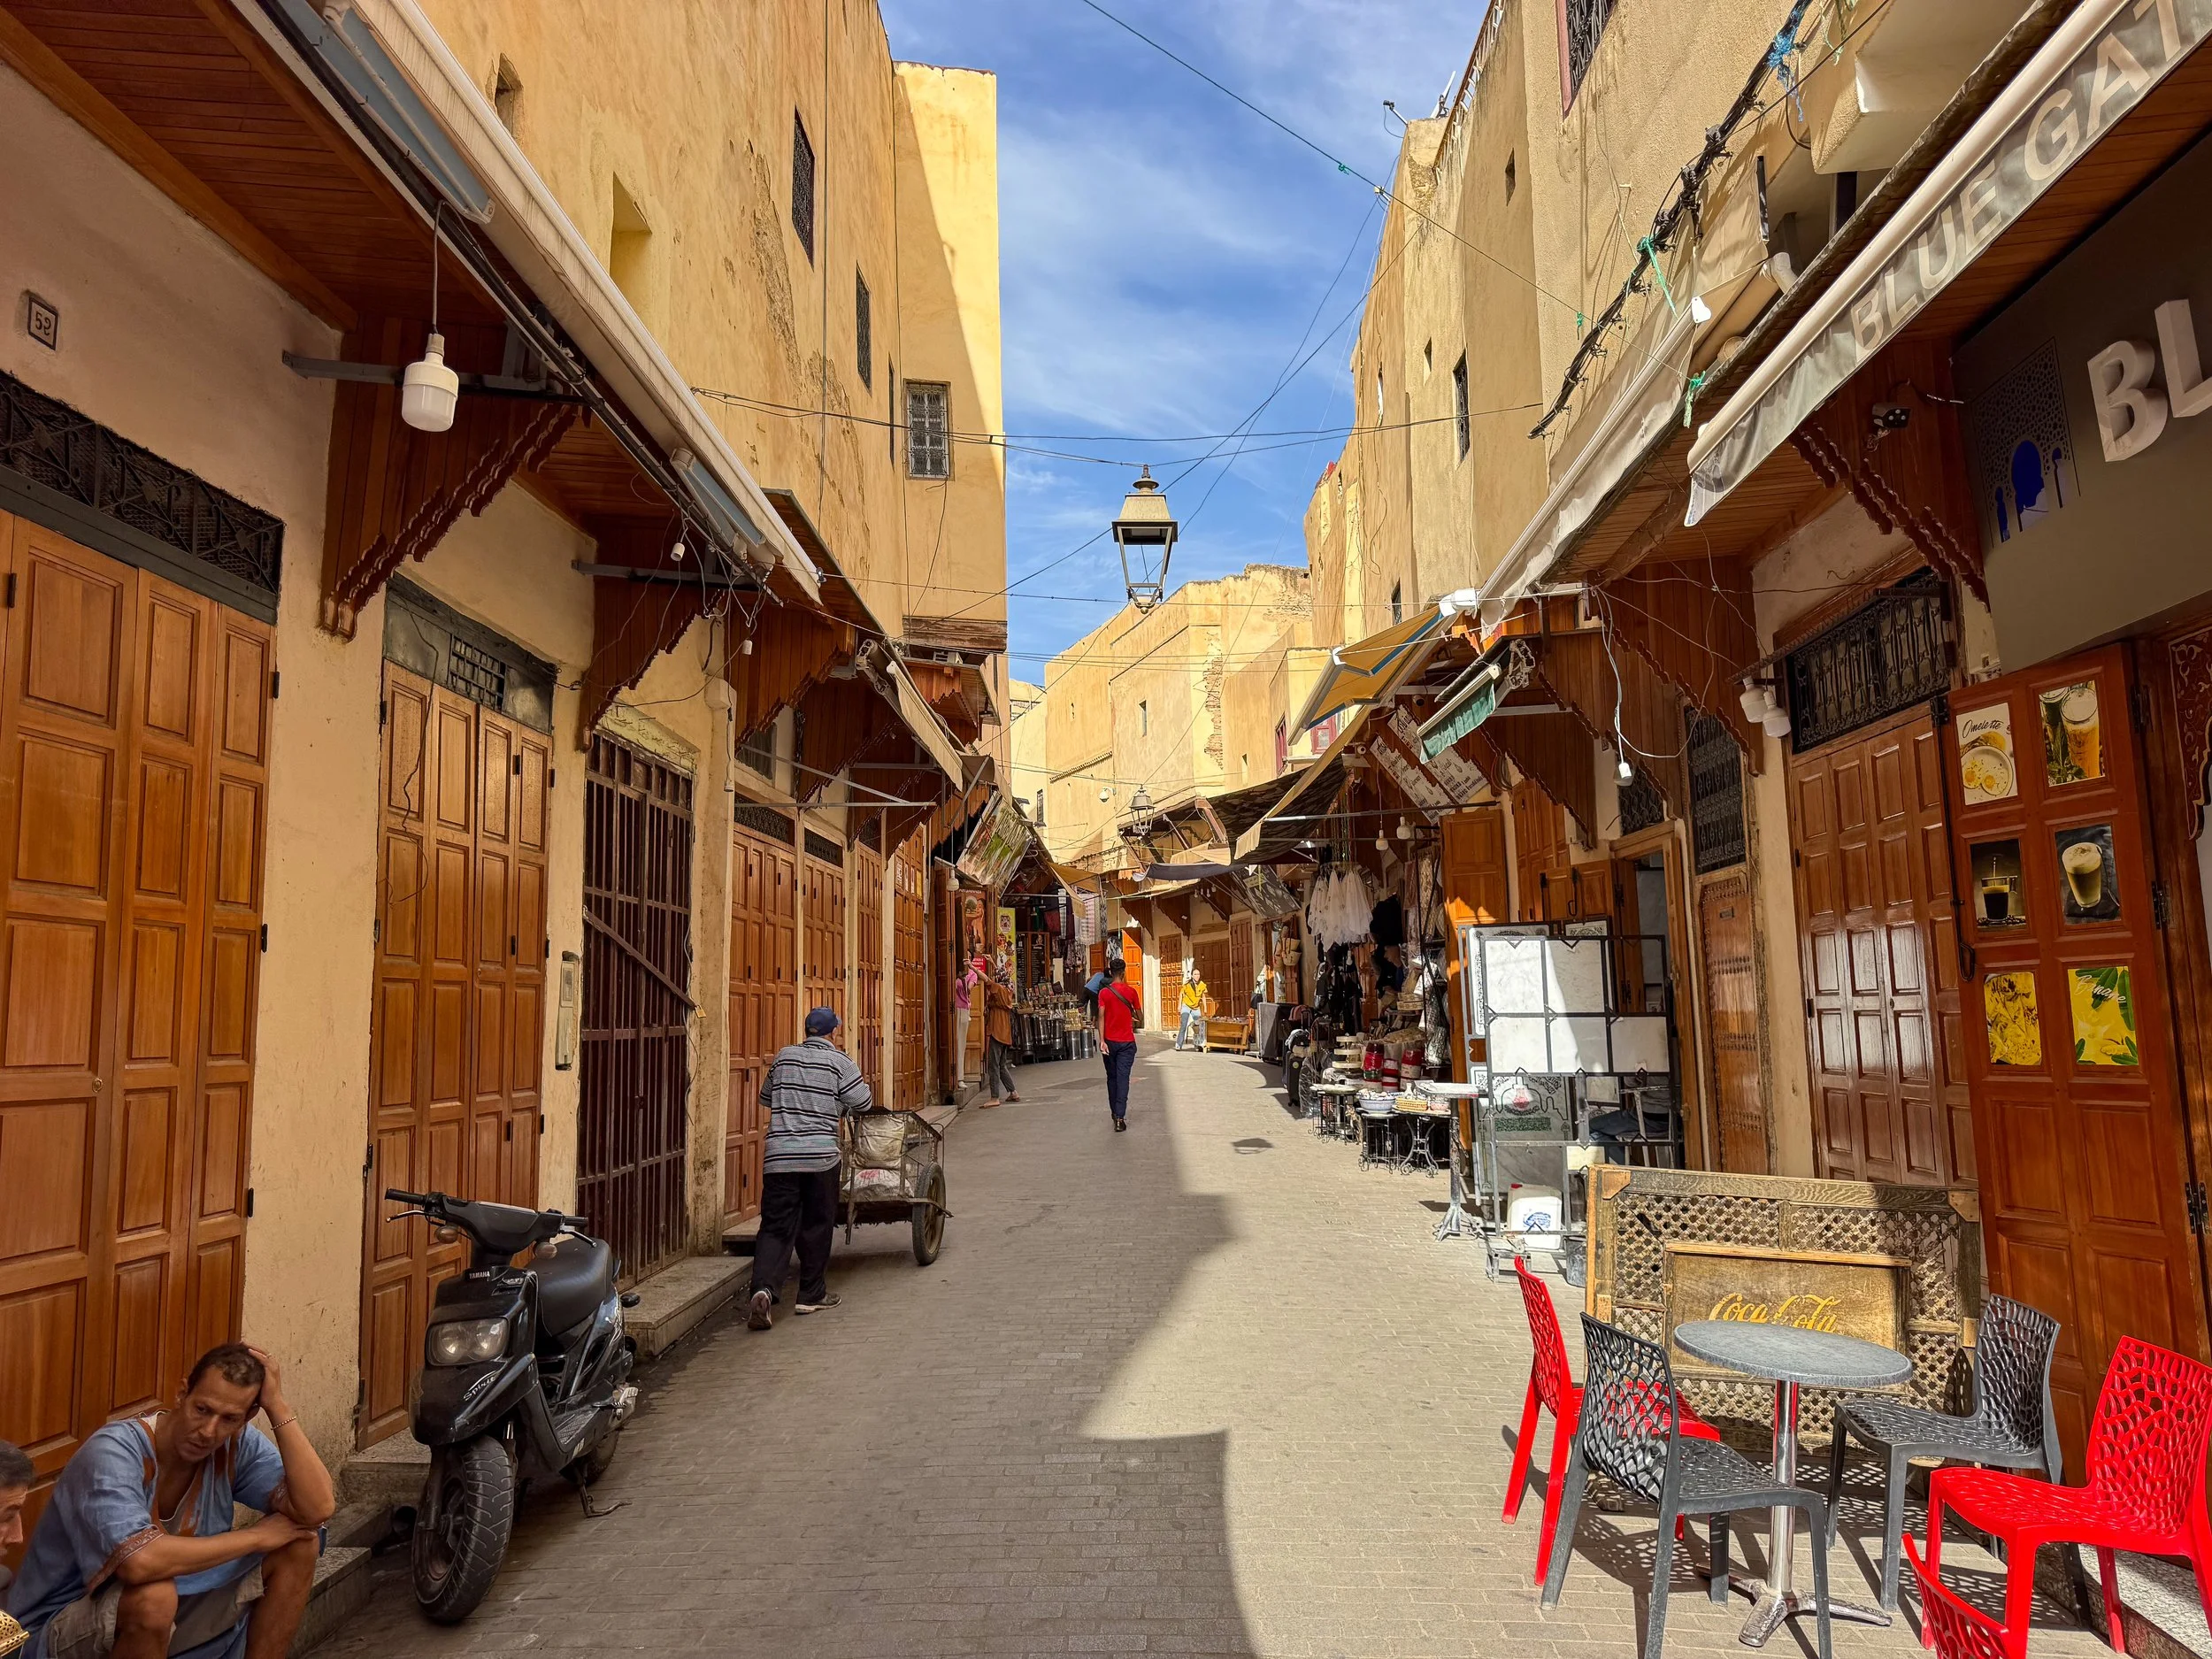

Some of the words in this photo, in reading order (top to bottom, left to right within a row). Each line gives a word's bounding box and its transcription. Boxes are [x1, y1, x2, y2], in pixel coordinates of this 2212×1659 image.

[1851, 161, 2003, 353] BLUE
[35, 311, 51, 336] 52
[1962, 719, 2004, 739] Omelette
[2074, 974, 2127, 1003] Banane
[468, 1271, 490, 1279] YAMAHA
[463, 1376, 496, 1402] Spirit
